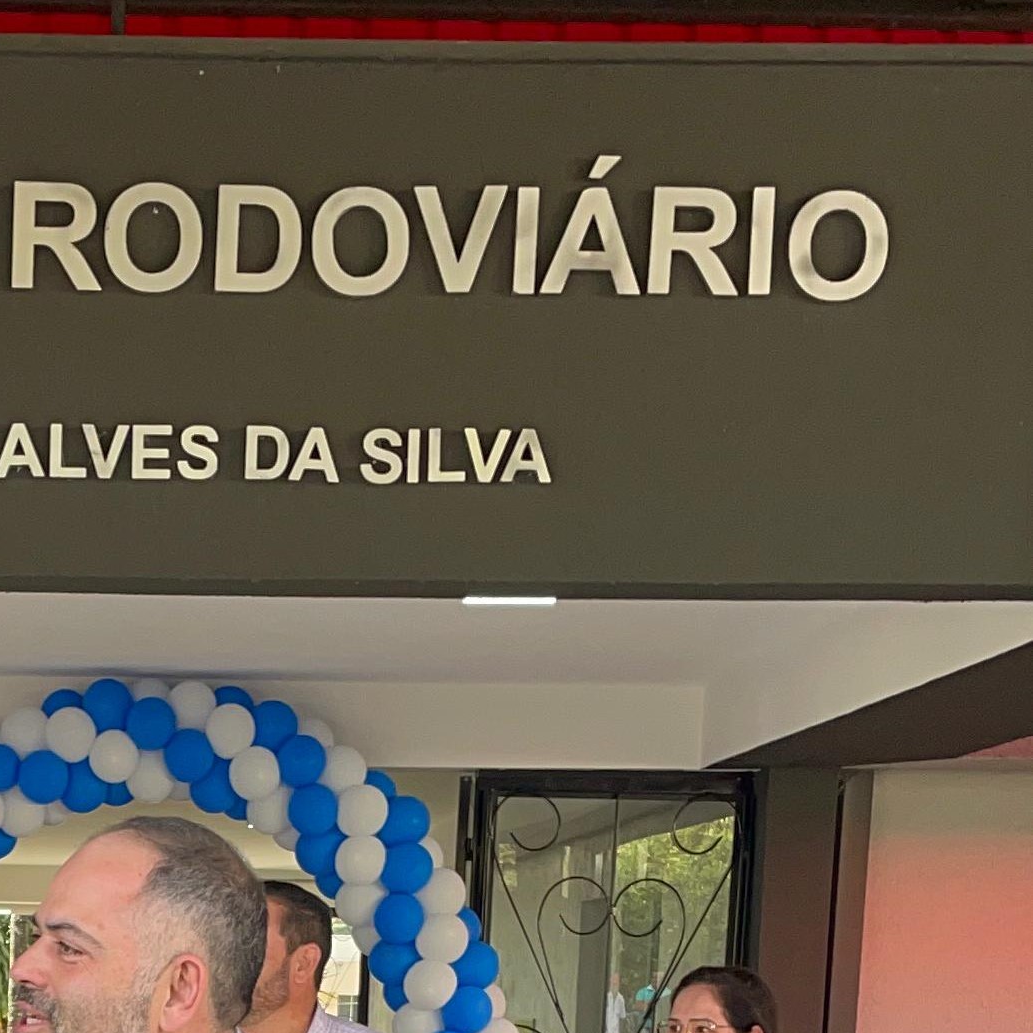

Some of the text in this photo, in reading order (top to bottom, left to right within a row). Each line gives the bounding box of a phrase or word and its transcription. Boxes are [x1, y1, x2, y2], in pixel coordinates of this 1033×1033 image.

[11, 154, 889, 302] RODOVIÁRIO
[244, 424, 340, 484] DA
[359, 427, 552, 485] SILVA
